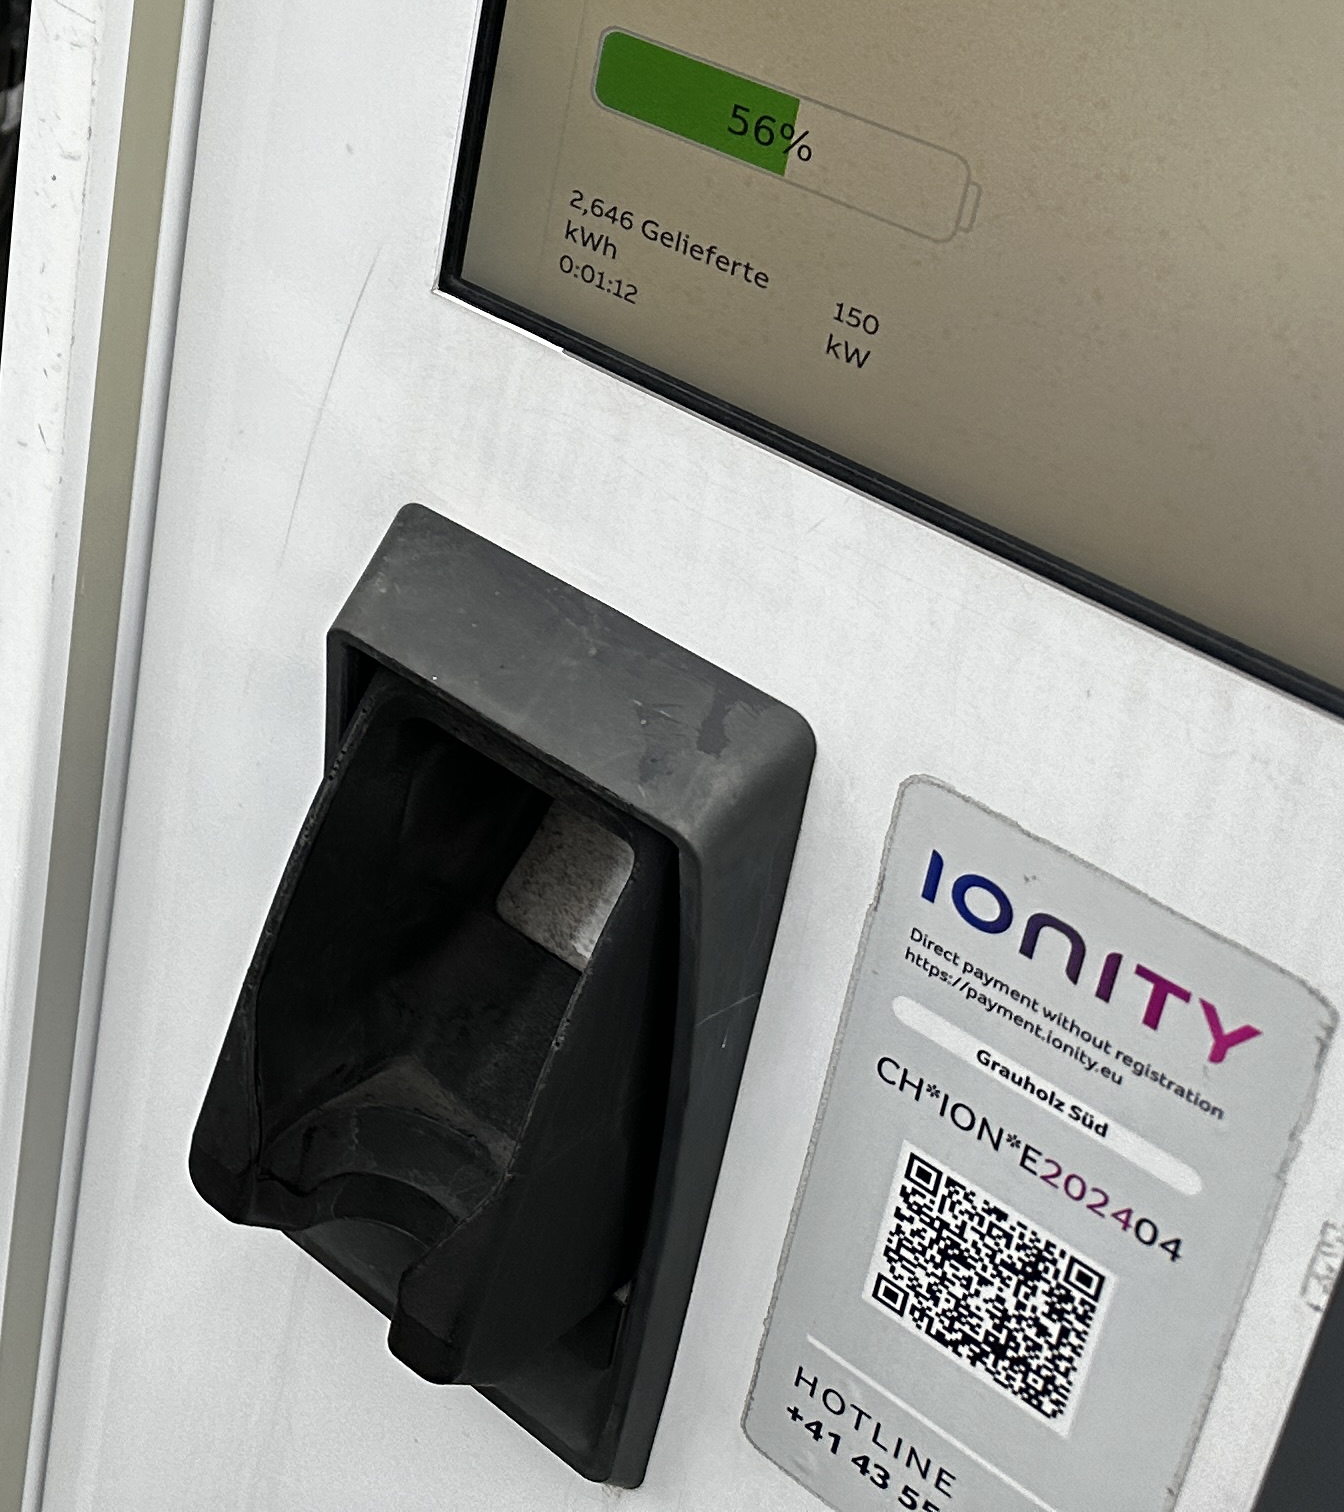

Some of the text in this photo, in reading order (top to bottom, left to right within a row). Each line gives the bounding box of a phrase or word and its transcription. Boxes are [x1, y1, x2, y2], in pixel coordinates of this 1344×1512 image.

[727, 104, 812, 162] 56%
[559, 254, 639, 305] 0:01:12
[564, 219, 618, 260] kWh
[569, 189, 770, 289] 2,646 Gelieferte
[825, 333, 872, 369] kW
[833, 302, 880, 336] 150
[920, 848, 1263, 1065] IONITY
[904, 946, 1124, 1086] https://payment.ionity.eu
[909, 926, 1225, 1120] Direct payment without registration
[976, 1048, 1109, 1138] Grauholz Süd
[786, 1405, 842, 1456] +41
[851, 1454, 890, 1490] 43
[793, 1365, 957, 1500] HOTLINE
